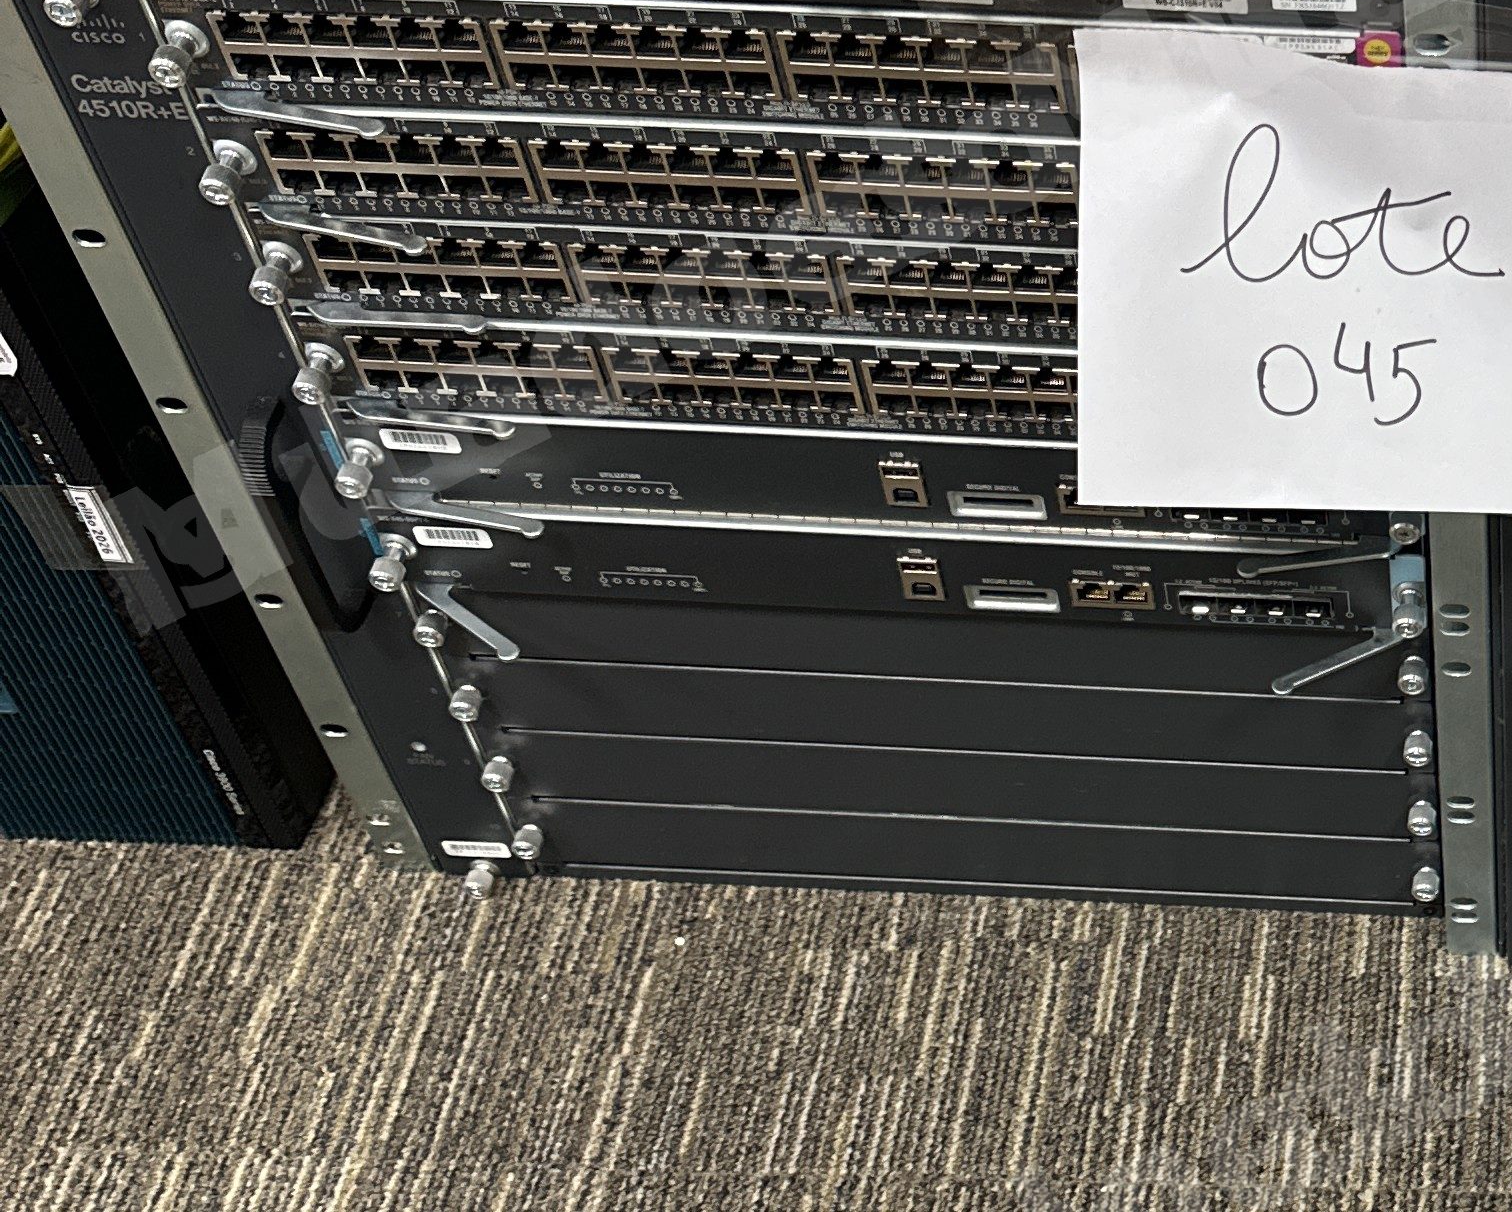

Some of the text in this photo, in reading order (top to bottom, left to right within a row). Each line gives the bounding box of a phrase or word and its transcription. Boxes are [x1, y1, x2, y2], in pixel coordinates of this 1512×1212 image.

[78, 98, 190, 121] 4510R+E
[1257, 321, 1437, 426] 045
[74, 495, 115, 555] Leilão 2026
